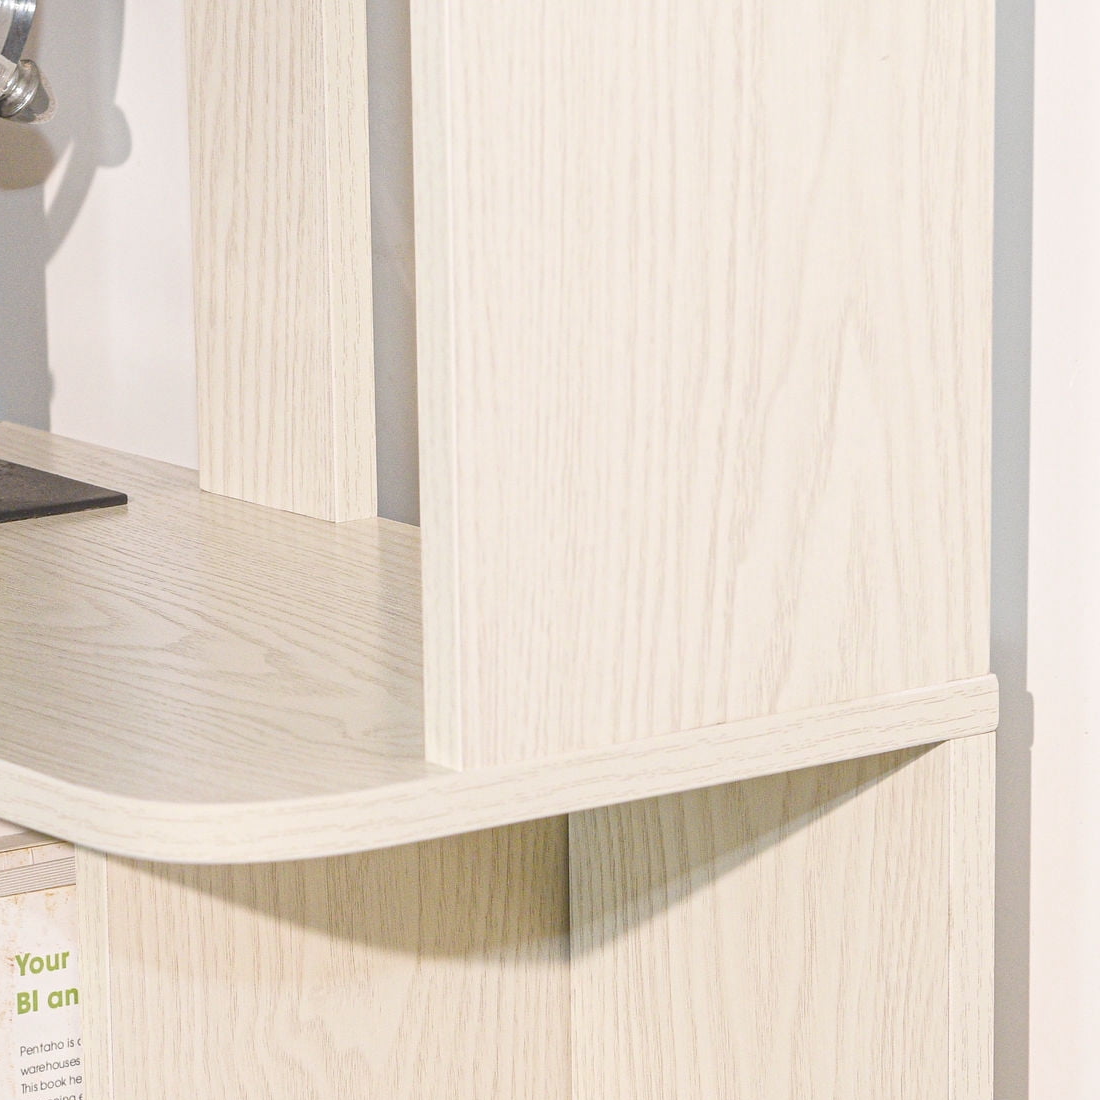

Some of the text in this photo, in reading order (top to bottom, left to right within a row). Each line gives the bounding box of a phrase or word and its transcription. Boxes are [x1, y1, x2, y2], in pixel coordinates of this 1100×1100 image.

[15, 951, 70, 976] Your
[17, 987, 79, 1015] BI an
[20, 1041, 64, 1056] Pentaho
[67, 1038, 74, 1048] is
[21, 1057, 81, 1076] warehouses
[21, 1075, 83, 1094] This book he
